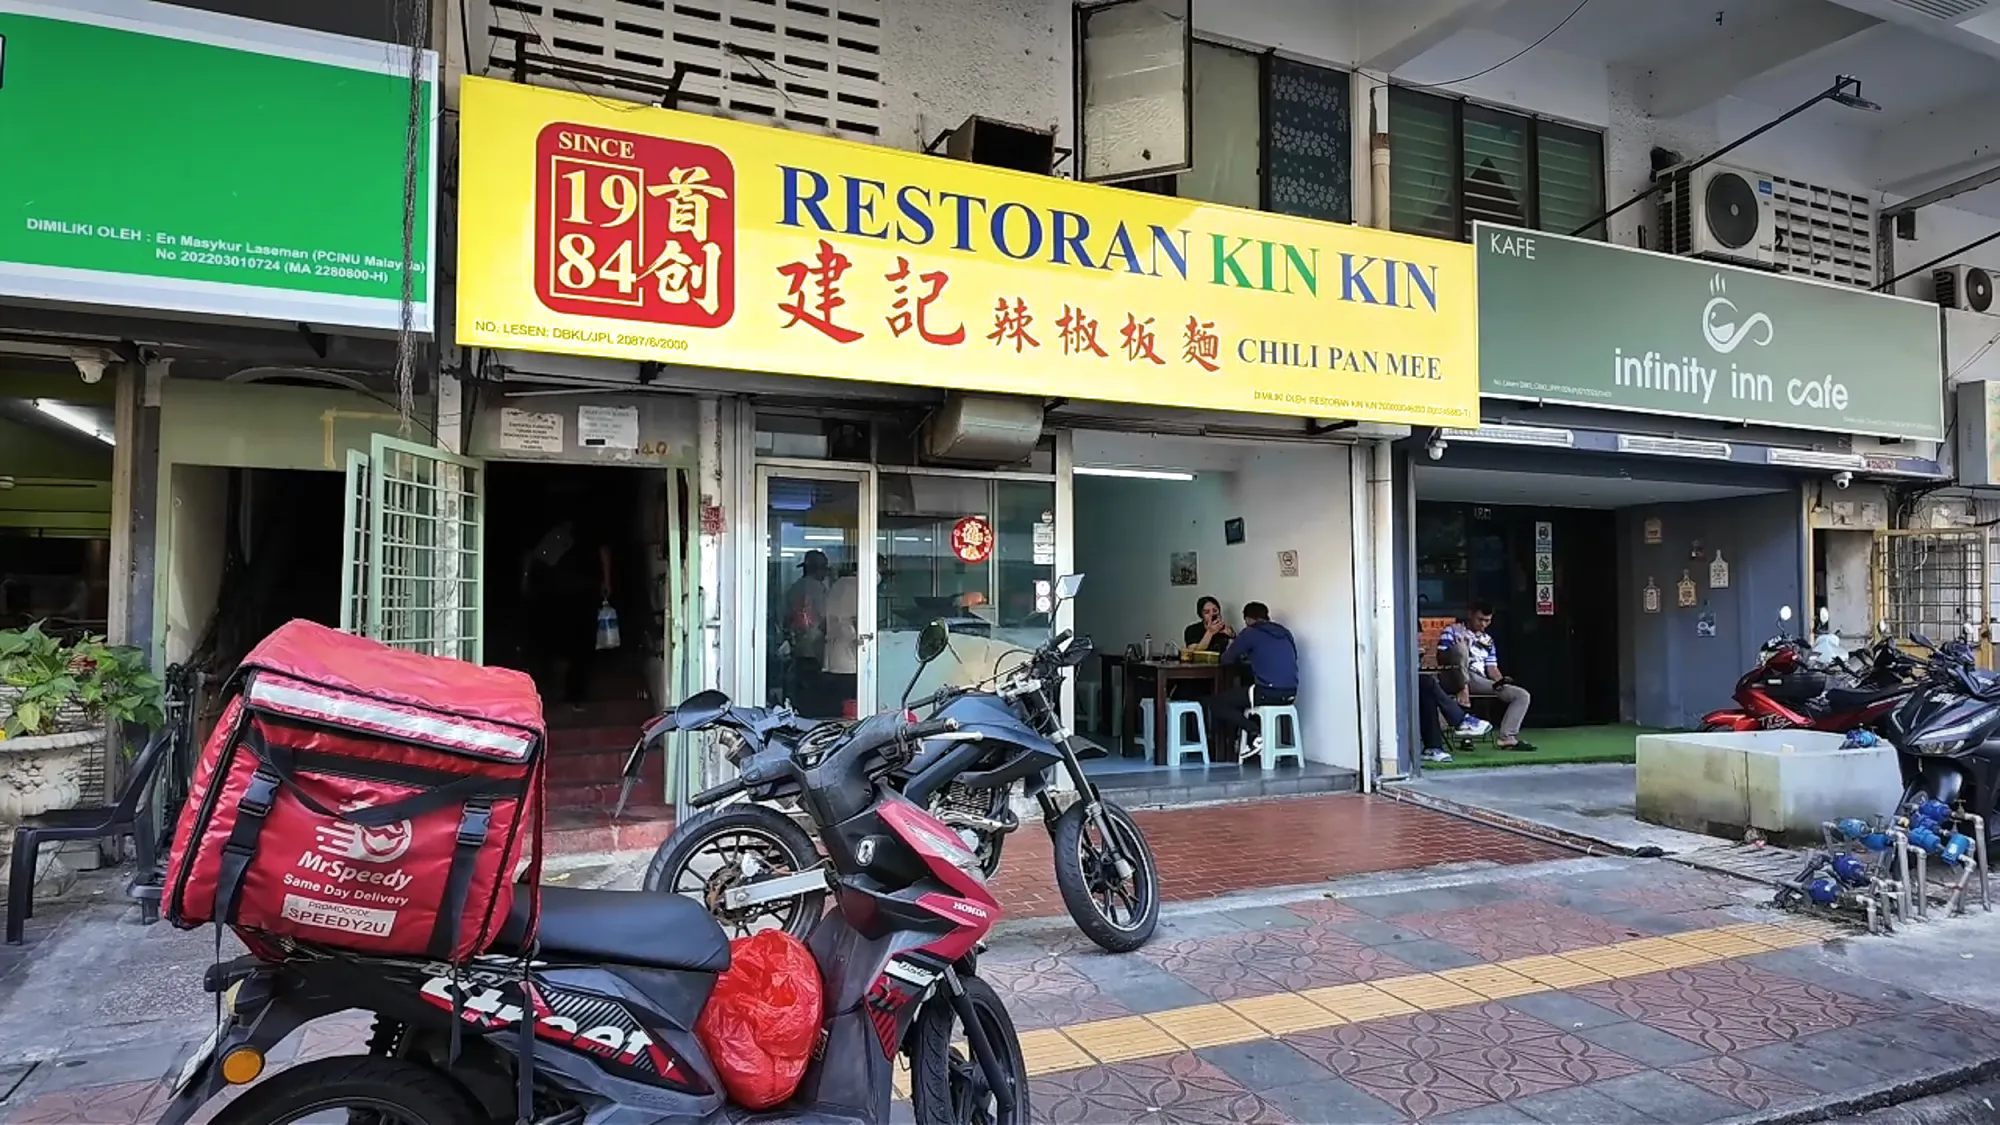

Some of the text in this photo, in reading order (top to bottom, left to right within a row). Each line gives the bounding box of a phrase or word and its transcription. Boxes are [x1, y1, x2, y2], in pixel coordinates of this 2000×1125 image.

[558, 131, 635, 159] SINCE
[561, 169, 638, 228] 19
[26, 217, 94, 237] DIMILIKI
[97, 227, 142, 241] OLEH
[156, 232, 176, 246] En
[180, 235, 242, 255] Masykur
[312, 249, 360, 267] (PCINU
[646, 165, 729, 316] 首创
[776, 164, 1439, 314] RESTORAN KIN KIN
[1490, 233, 1536, 260] KAFE
[156, 248, 389, 284] No 202203010724 (MA 2280800-H)
[557, 233, 637, 293] 84
[775, 239, 1442, 381] 建記 辣椒板麵 CHILI PAN MEE
[552, 327, 614, 345] DBKL/JPL
[1614, 347, 1718, 405] infinity
[1730, 362, 1773, 402] inn
[1787, 373, 1849, 412] cafe
[283, 873, 409, 906] Same Day Delivery
[297, 850, 413, 891] MrSpeedy
[288, 907, 386, 934] SPEEDY2U
[307, 900, 371, 917] PROMOCODE
[952, 901, 987, 918] HONDA
